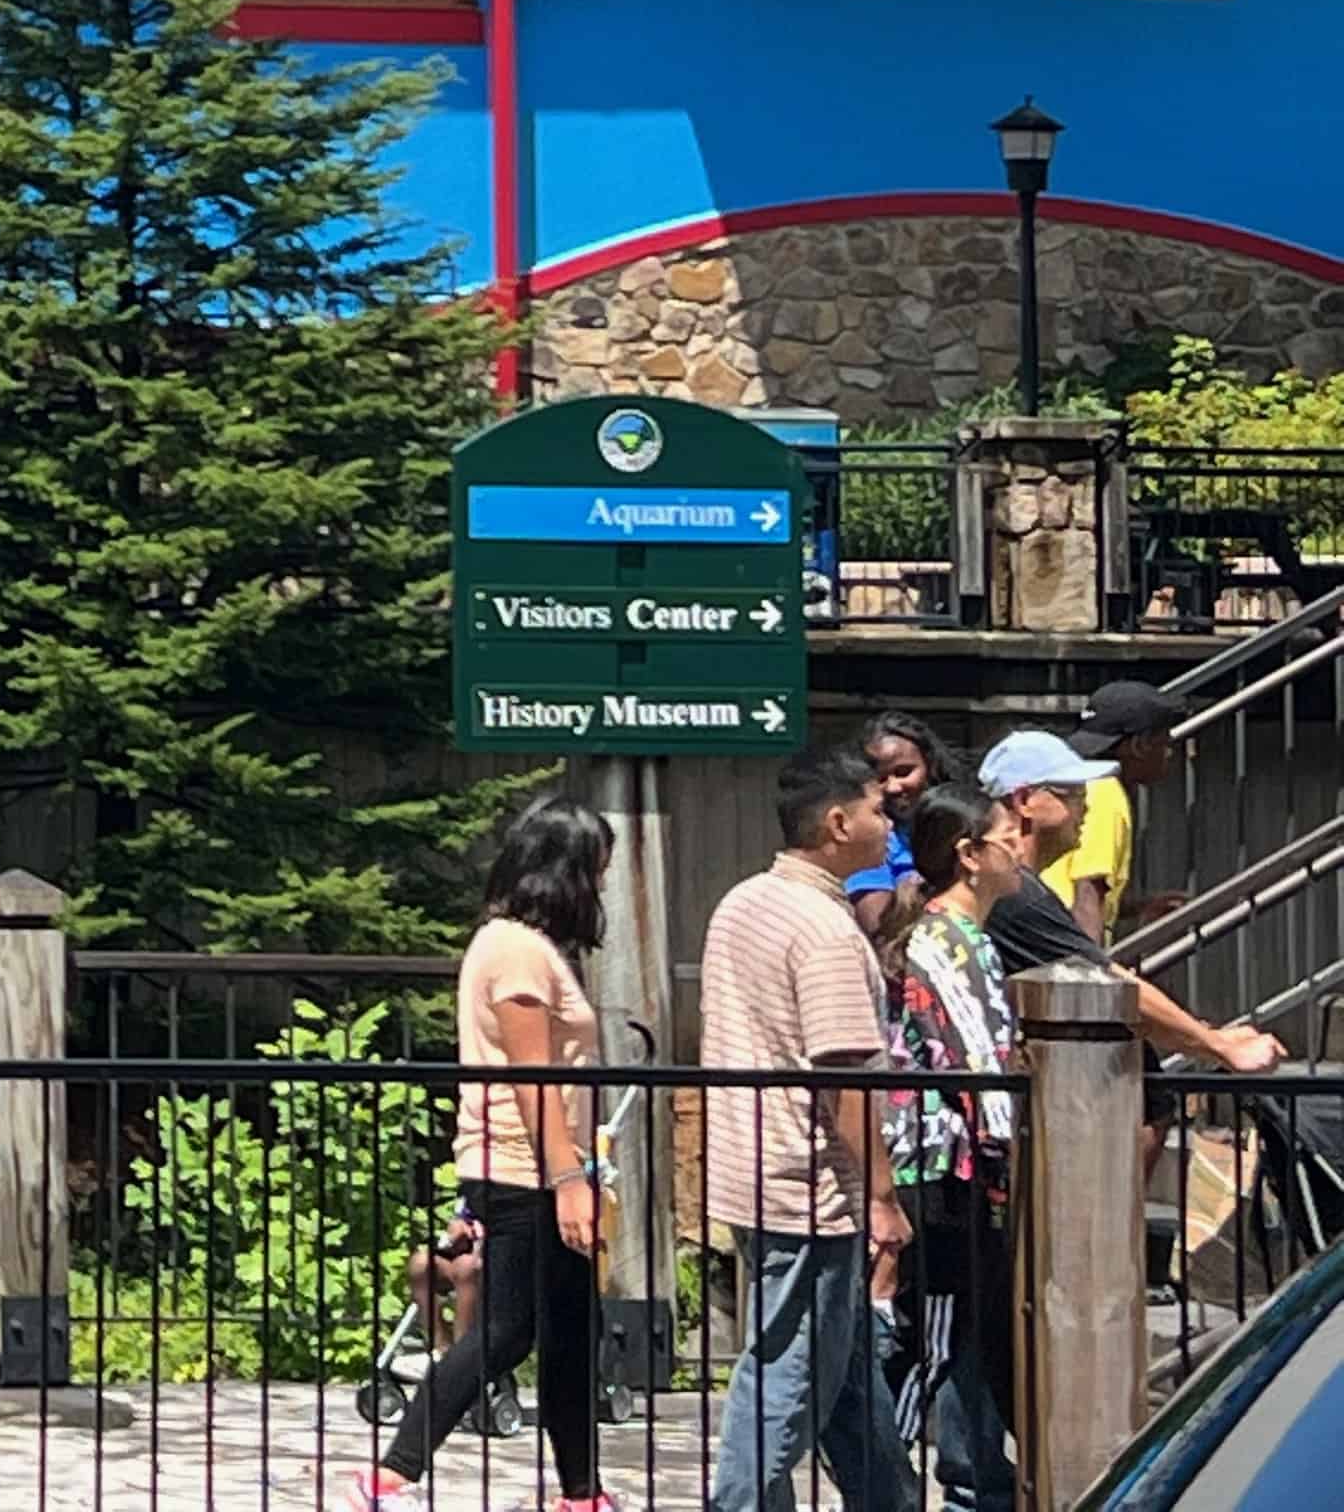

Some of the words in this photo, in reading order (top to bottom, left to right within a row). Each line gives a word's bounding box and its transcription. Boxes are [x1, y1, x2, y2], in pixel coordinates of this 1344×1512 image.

[586, 497, 735, 534] Aquarium
[492, 597, 612, 630] Visitors
[625, 598, 738, 631] Center
[482, 695, 595, 734] History
[602, 695, 741, 727] Museum
